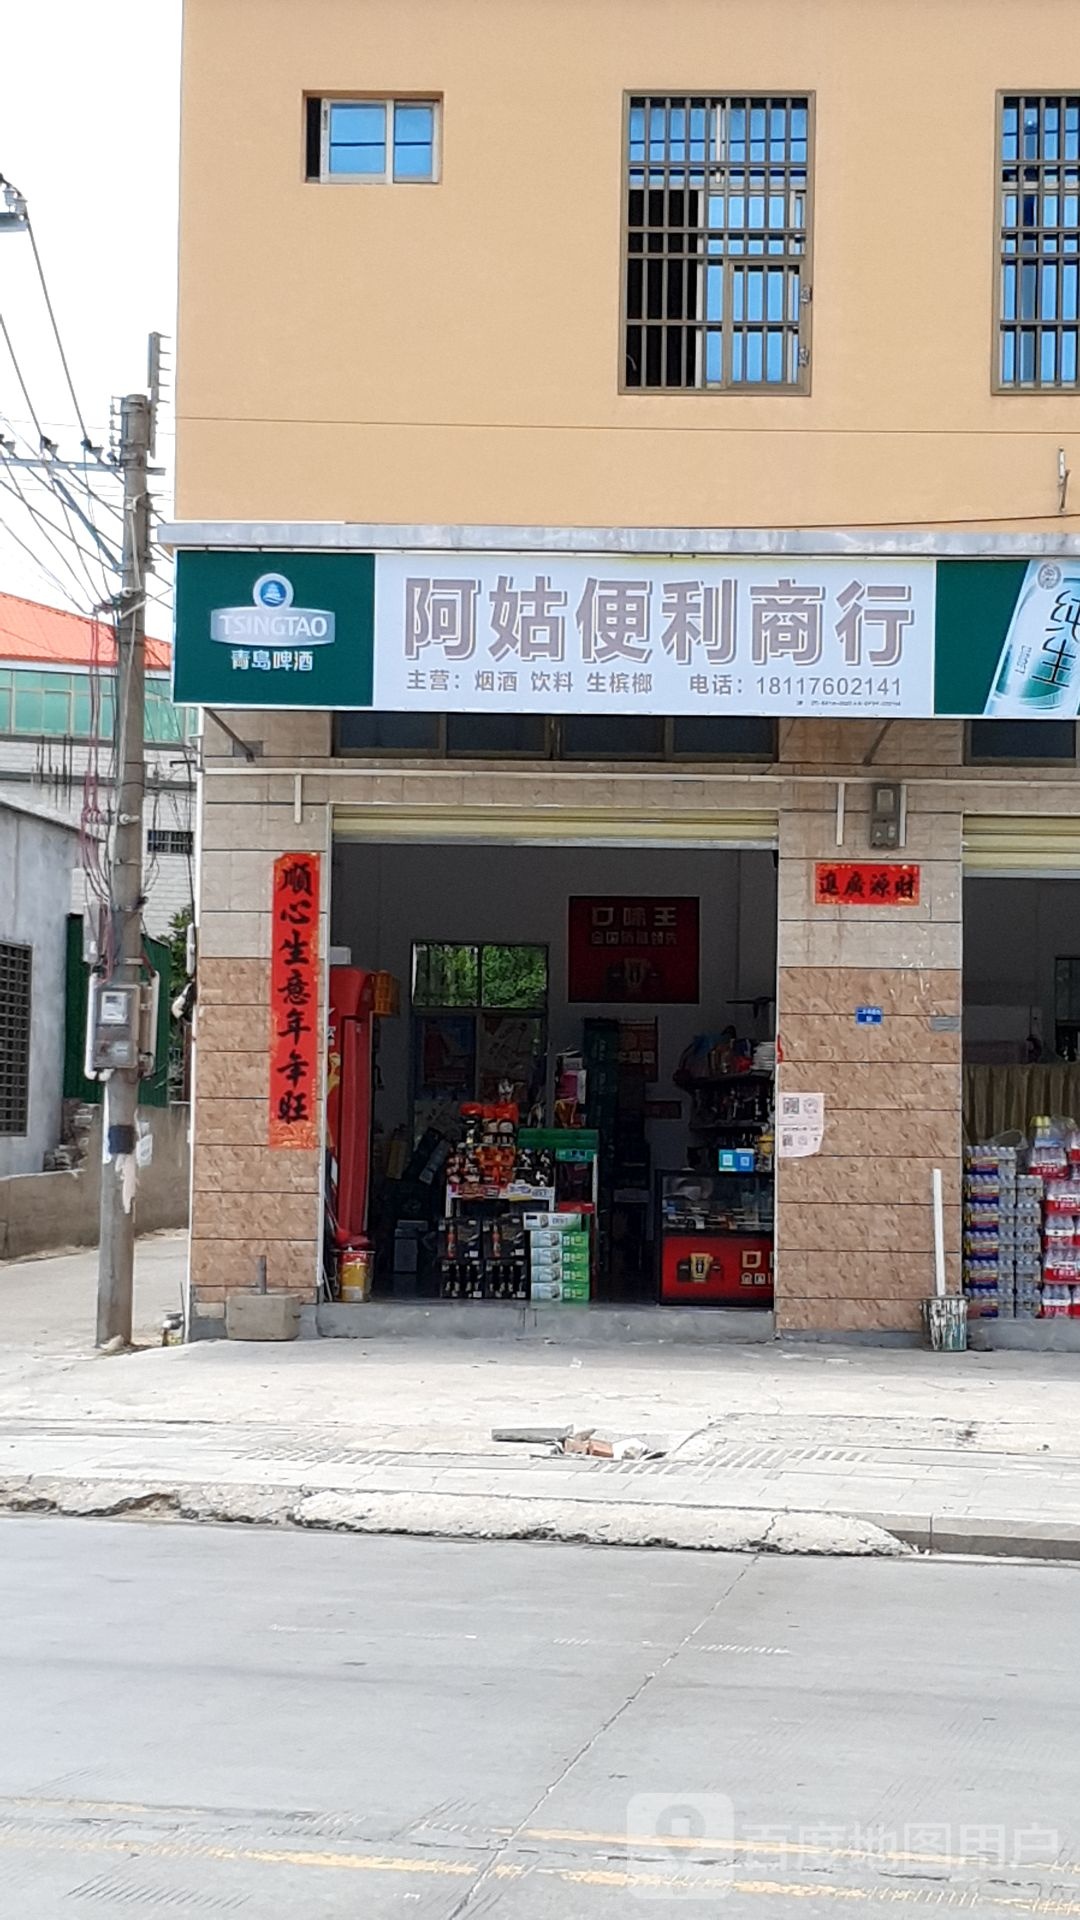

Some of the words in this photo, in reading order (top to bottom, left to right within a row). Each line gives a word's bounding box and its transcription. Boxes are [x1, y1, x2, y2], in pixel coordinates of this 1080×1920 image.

[219, 614, 327, 637] TSINGTAO
[404, 575, 915, 666] 阿姑便利商行
[231, 650, 313, 671] 青岛啤酒
[531, 671, 573, 693] 饮料
[587, 672, 653, 694] 生槟榔
